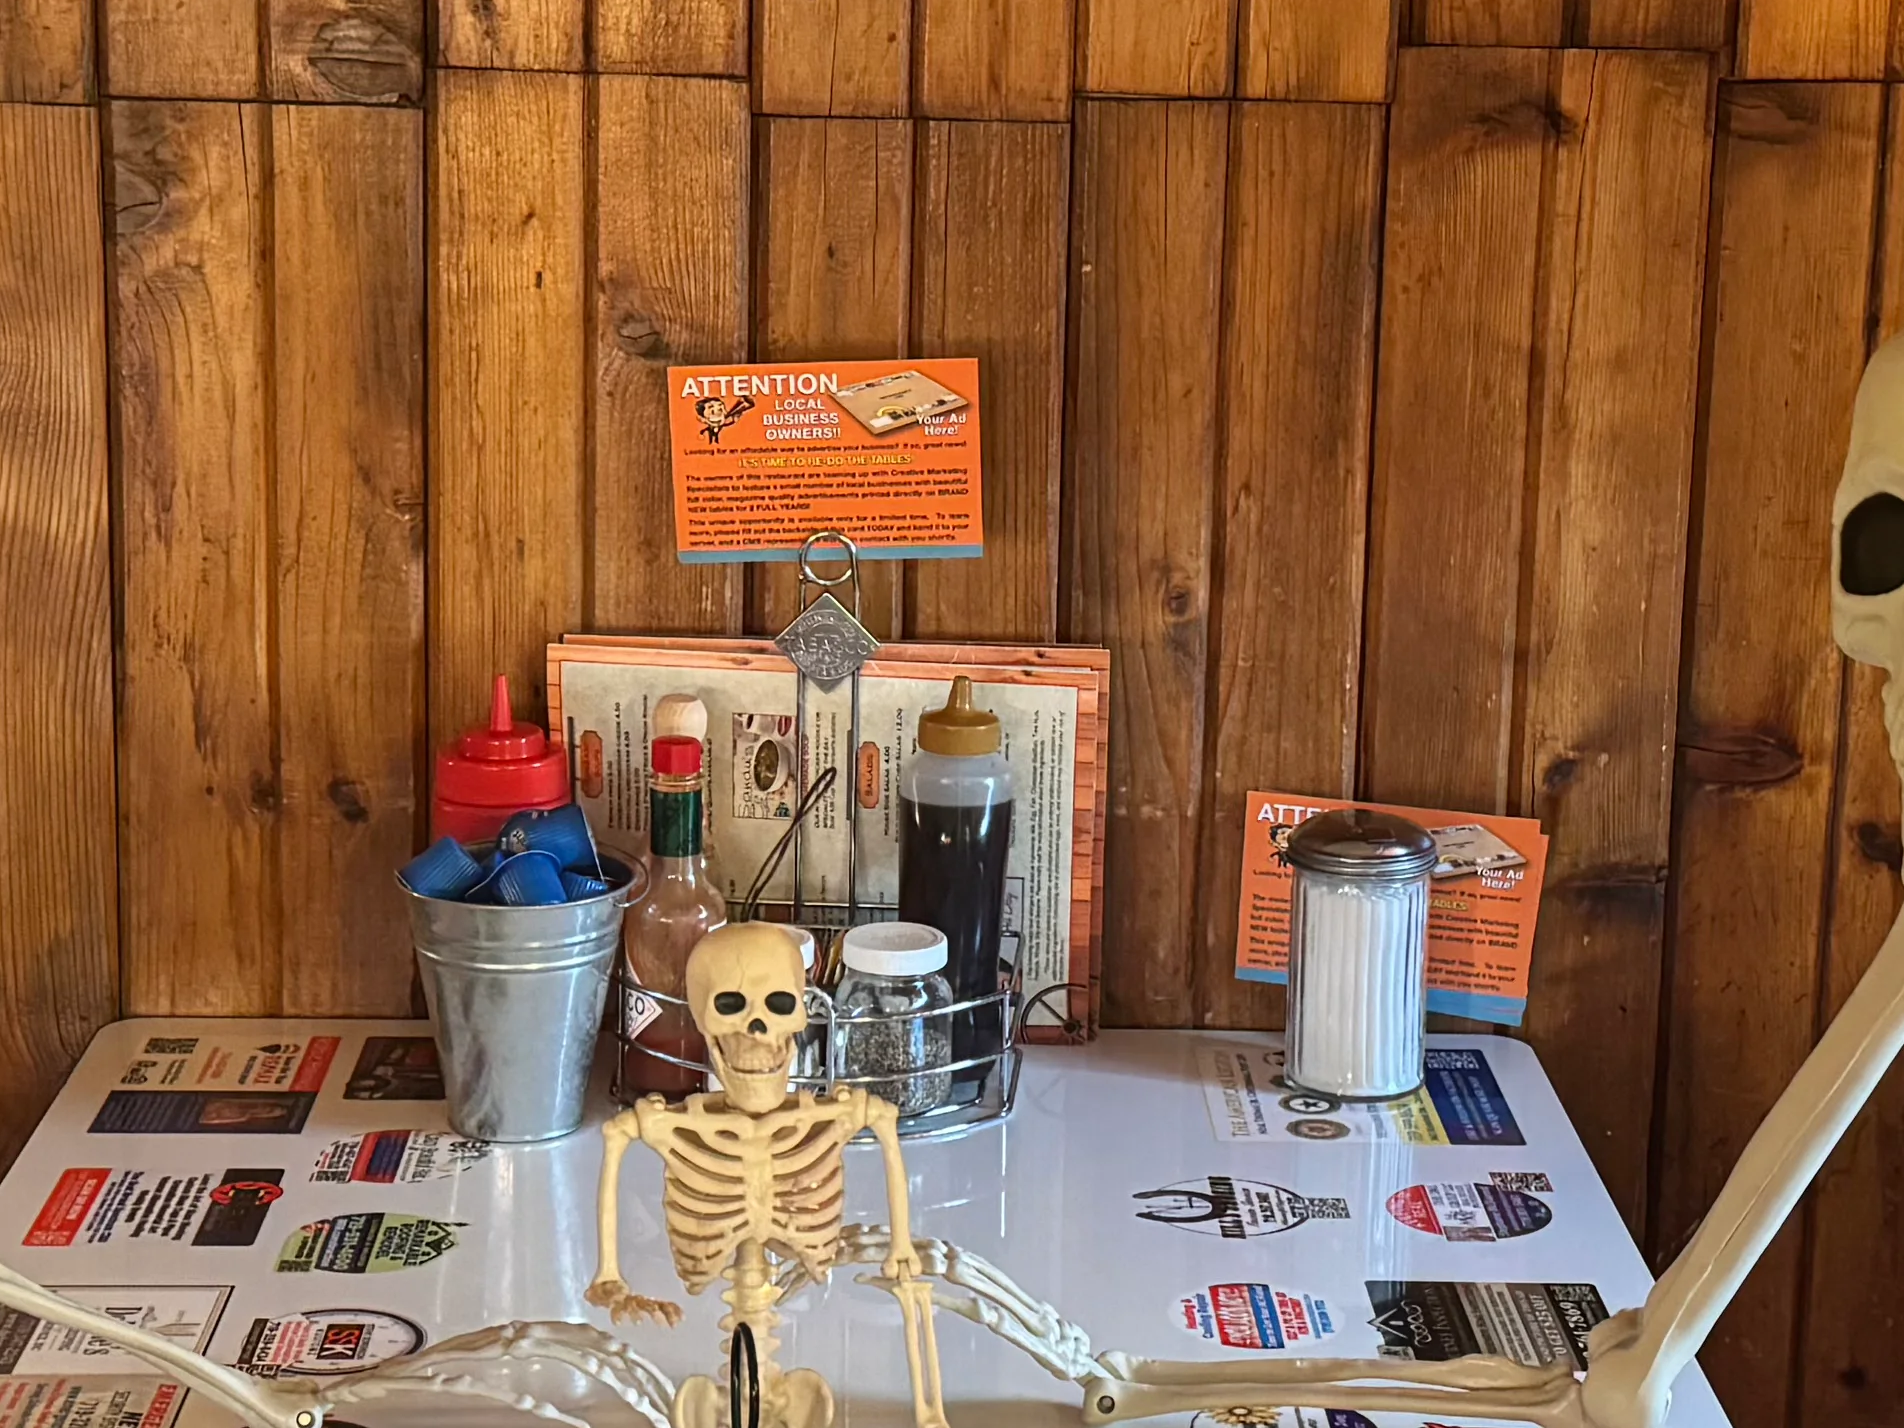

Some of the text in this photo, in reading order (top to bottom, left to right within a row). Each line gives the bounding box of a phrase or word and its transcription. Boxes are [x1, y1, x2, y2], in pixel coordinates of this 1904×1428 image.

[679, 372, 839, 398] ATTENTION
[774, 398, 824, 411] LOCAL
[762, 412, 839, 426] BUSINESS
[915, 413, 966, 425] Your Ad
[765, 427, 841, 440] OWNERS!!
[923, 424, 958, 436] Here!
[761, 457, 787, 467] TIME
[789, 457, 805, 466] TO
[890, 468, 925, 477] Creative
[926, 467, 968, 477] Marketing
[937, 488, 969, 497] BRAND
[756, 503, 777, 511] FULL
[866, 524, 895, 532] TODAY
[1476, 866, 1524, 881] Your Ad
[1481, 877, 1516, 889] Here!
